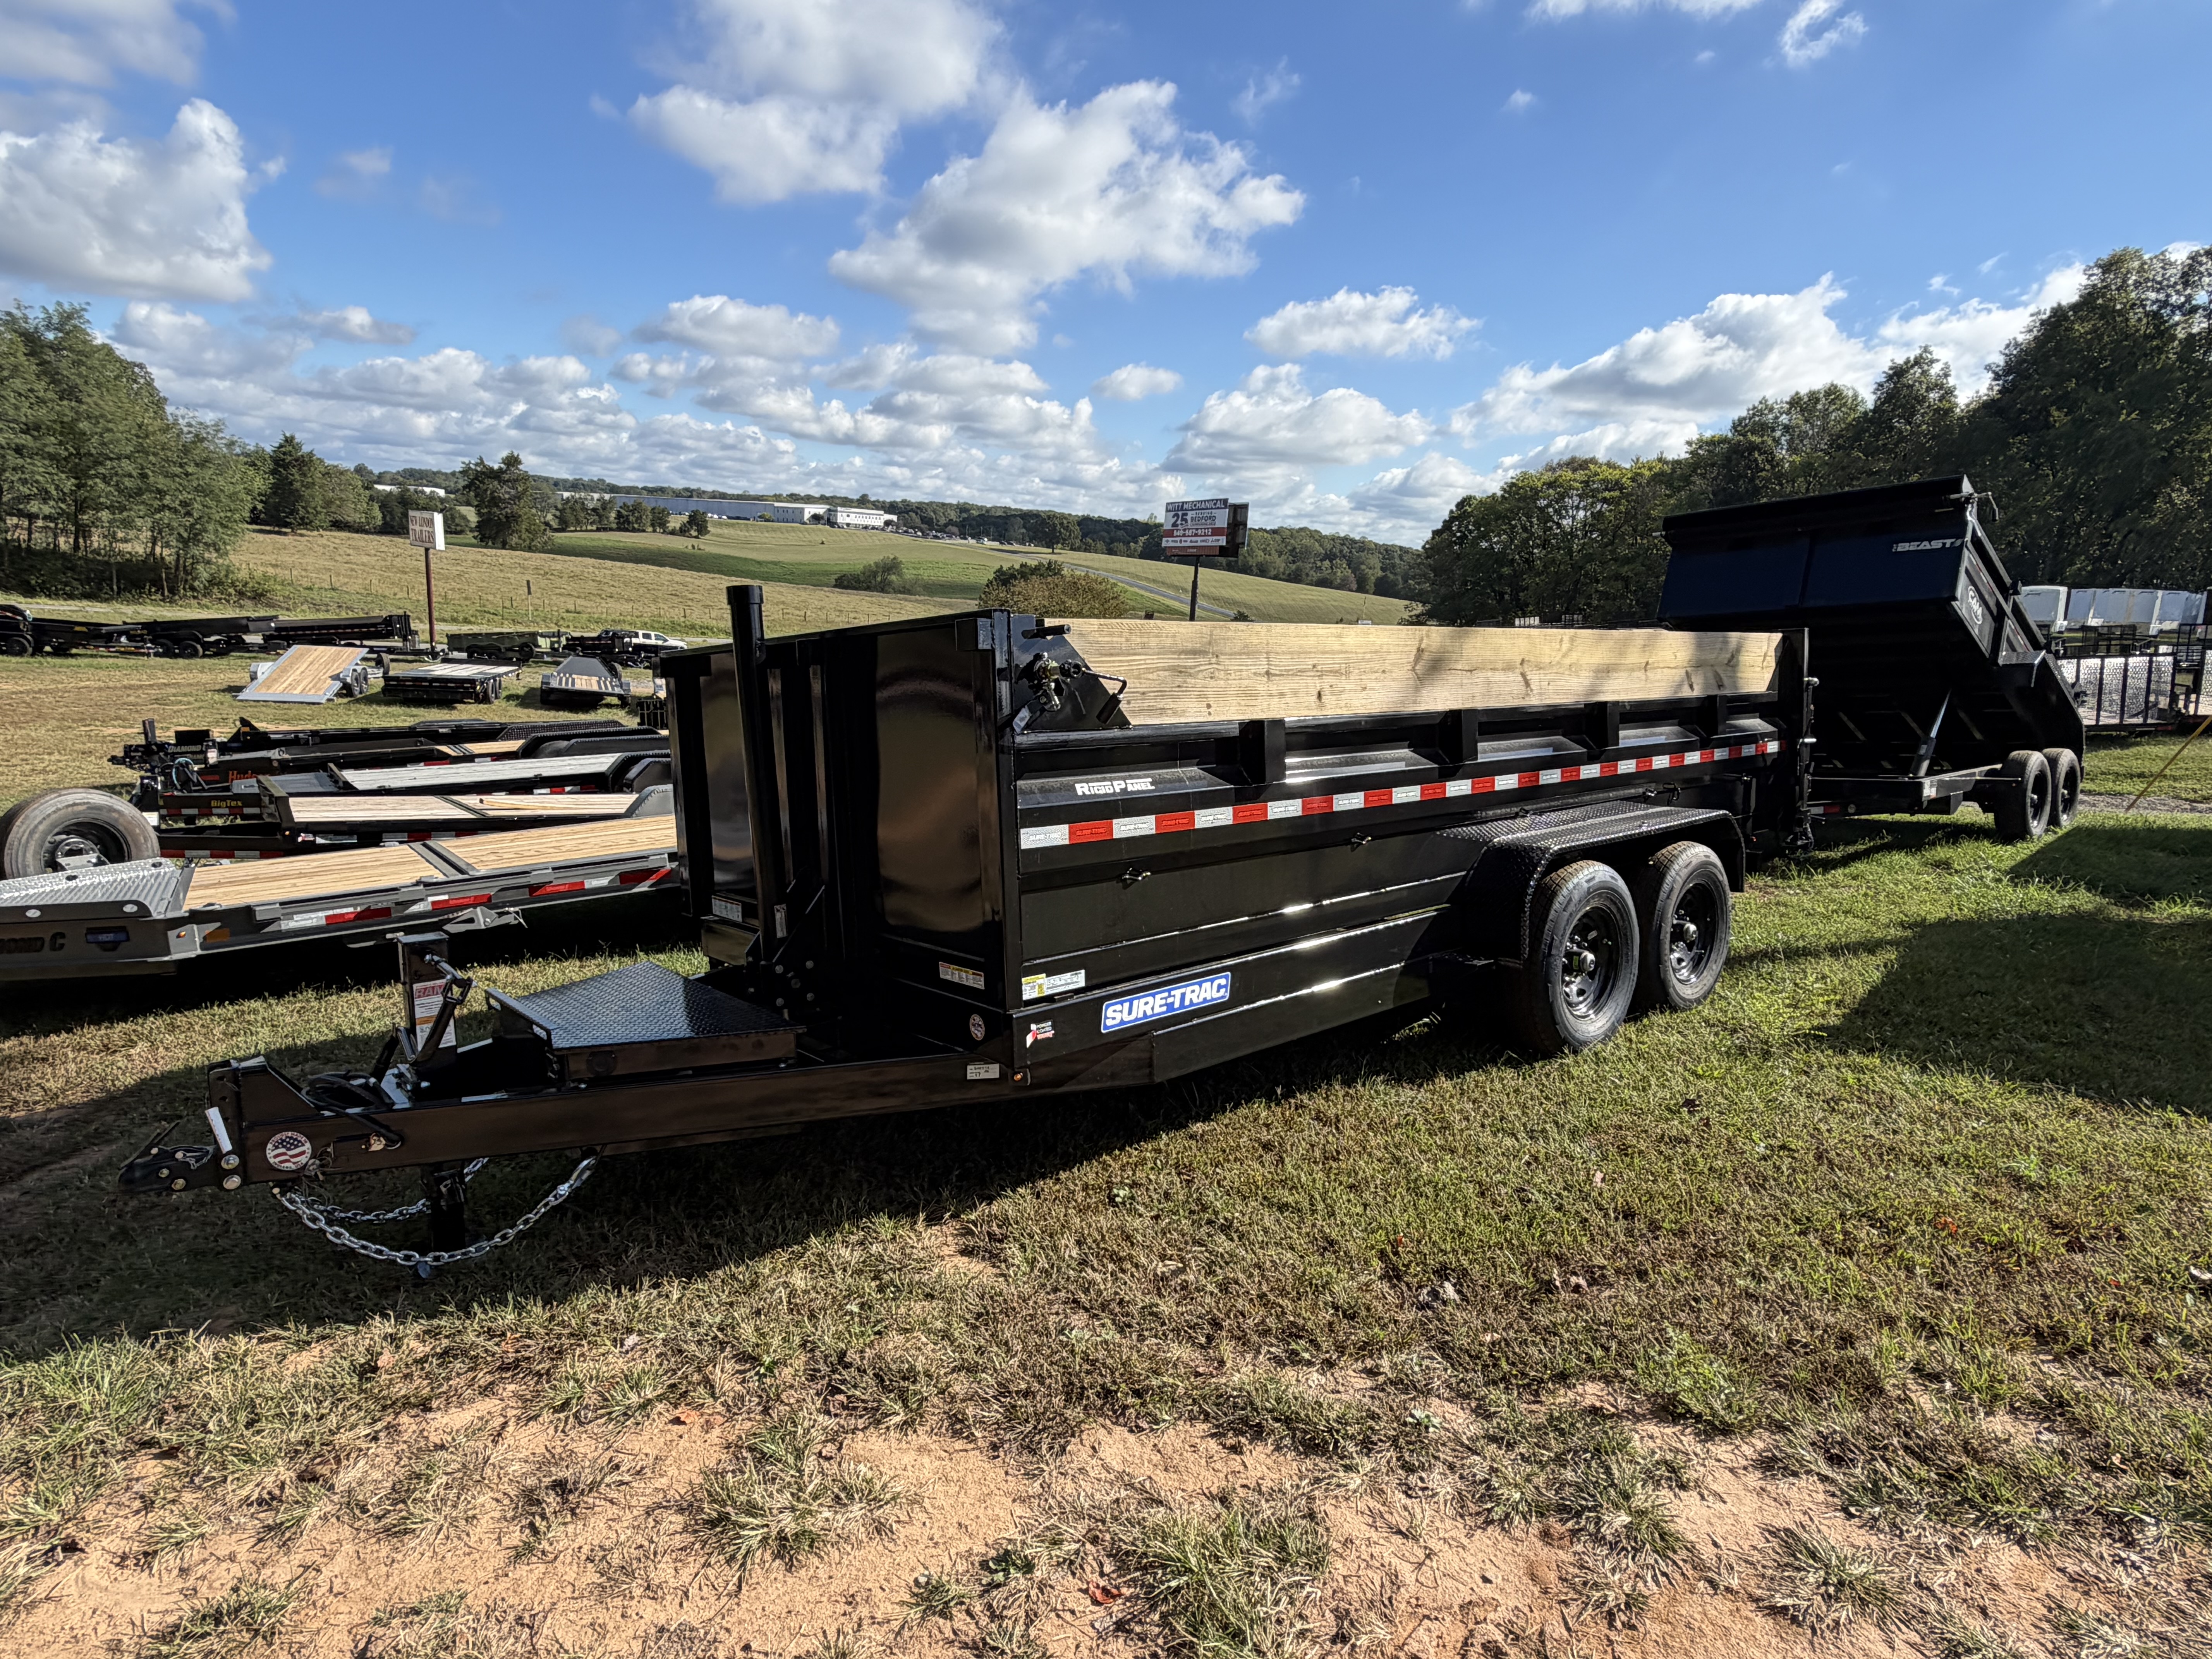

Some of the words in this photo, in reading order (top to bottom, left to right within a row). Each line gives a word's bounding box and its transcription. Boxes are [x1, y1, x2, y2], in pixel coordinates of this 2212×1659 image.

[1167, 503, 1182, 511] WITT
[1183, 500, 1224, 510] MECHANICAL
[1171, 512, 1188, 527] 25
[1897, 539, 1956, 551] BEAST
[211, 800, 243, 808] BigTex
[1105, 978, 1227, 1026] SURE-TRAC
